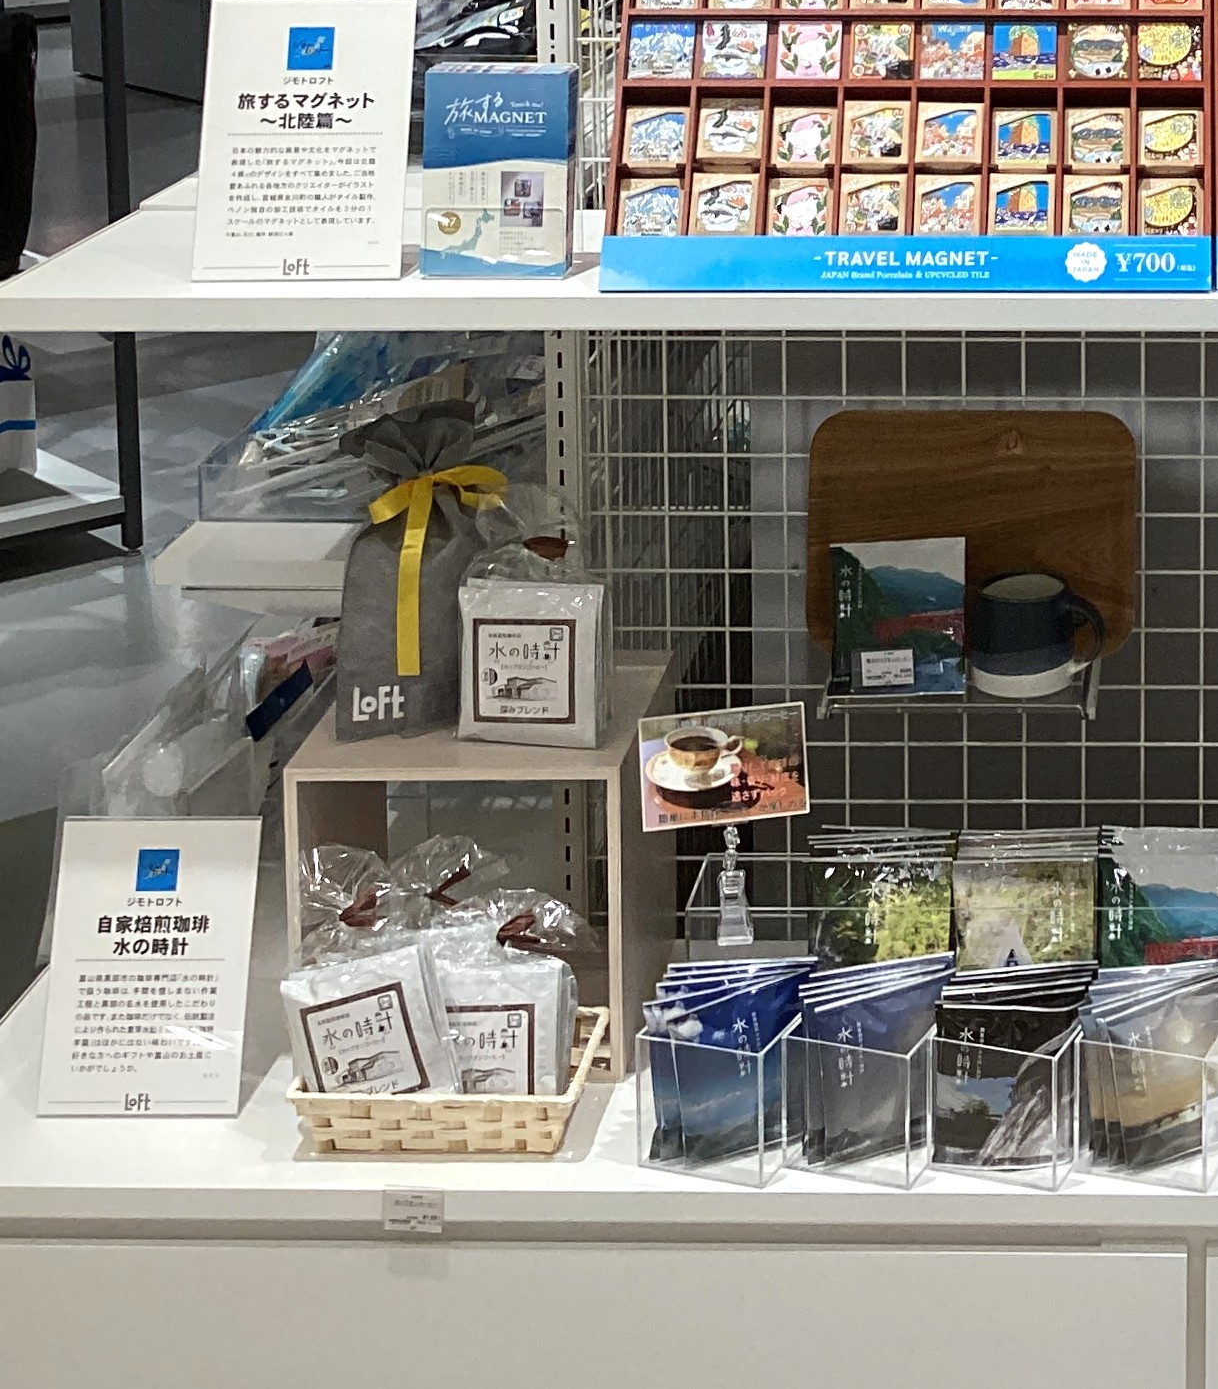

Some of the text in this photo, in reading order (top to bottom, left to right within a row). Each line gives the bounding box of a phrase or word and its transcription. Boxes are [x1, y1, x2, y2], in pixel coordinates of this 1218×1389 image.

[282, 75, 334, 85] ジモトロフト
[238, 92, 375, 111] 旅するマグネット
[473, 111, 547, 124] MAGNET
[1115, 252, 1175, 273] ¥700
[488, 640, 561, 662] 水の時計
[126, 896, 183, 908] ジモトロフト
[97, 914, 211, 935] 自家焙煎珈琲
[113, 936, 189, 956] 水の時計
[322, 1010, 394, 1047] 水の時計
